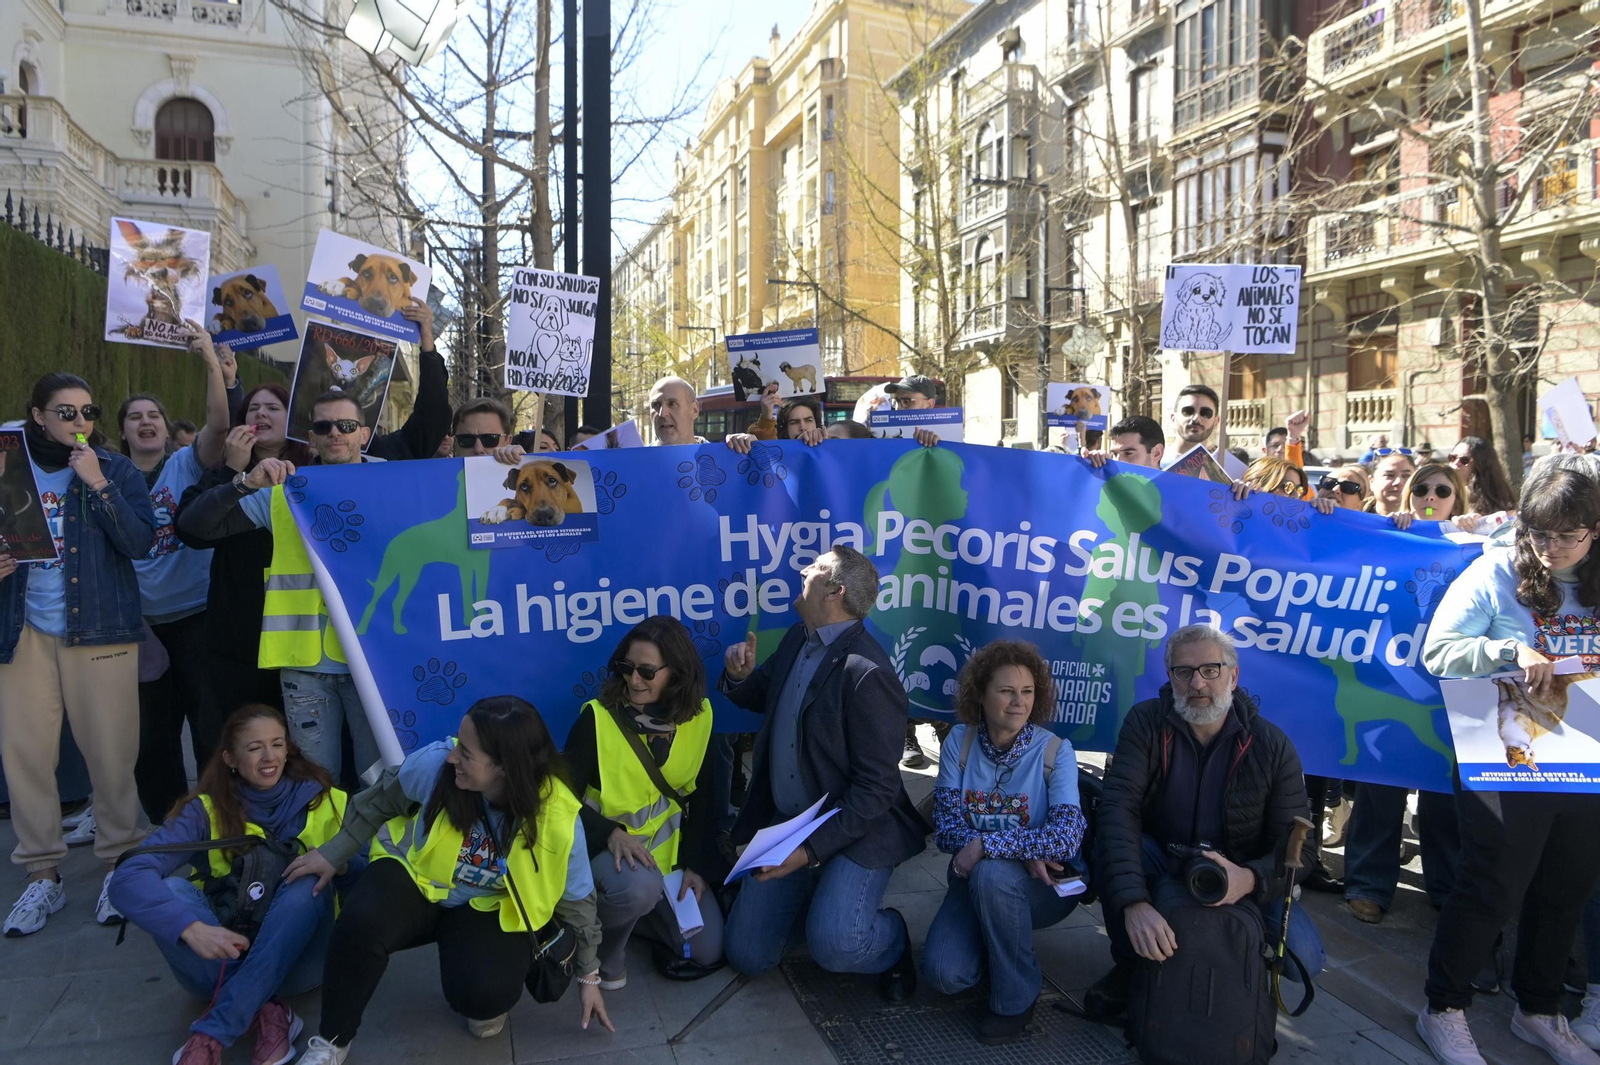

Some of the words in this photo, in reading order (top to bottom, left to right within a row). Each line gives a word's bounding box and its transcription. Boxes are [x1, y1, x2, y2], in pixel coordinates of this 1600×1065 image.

[516, 270, 539, 286] CON
[539, 273, 554, 288] SU
[556, 276, 587, 293] SALUD
[1252, 266, 1280, 284] LOS
[513, 288, 529, 304] NO
[148, 320, 165, 332] NO
[168, 326, 179, 334] AL
[334, 305, 354, 315] DEFENSA
[364, 314, 384, 324] CRITERIO
[386, 320, 414, 333] VETERINARIO
[349, 313, 364, 322] SALUD
[382, 323, 404, 334] ANIMALES
[1247, 307, 1265, 324] NO
[1269, 307, 1285, 324] SE
[1243, 323, 1291, 346] TOCAN
[508, 350, 526, 366] NO
[526, 353, 542, 369] AL
[508, 369, 522, 386] RD
[526, 371, 587, 394] 666/2023
[720, 509, 864, 574] Hygia
[876, 510, 1058, 575] Pecoris
[1064, 529, 1203, 588] Salus
[1209, 552, 1397, 618] Populi:
[437, 592, 504, 641] La
[516, 577, 714, 643] higiene
[724, 568, 790, 618] de
[875, 565, 1106, 635] animales
[1111, 600, 1170, 640] es
[1179, 594, 1222, 630] la
[1232, 612, 1384, 664] salud
[1384, 623, 1427, 668] d
[1052, 660, 1091, 677] OFICIAL
[1054, 679, 1112, 703] NARIOS
[1054, 702, 1097, 725] NADA
